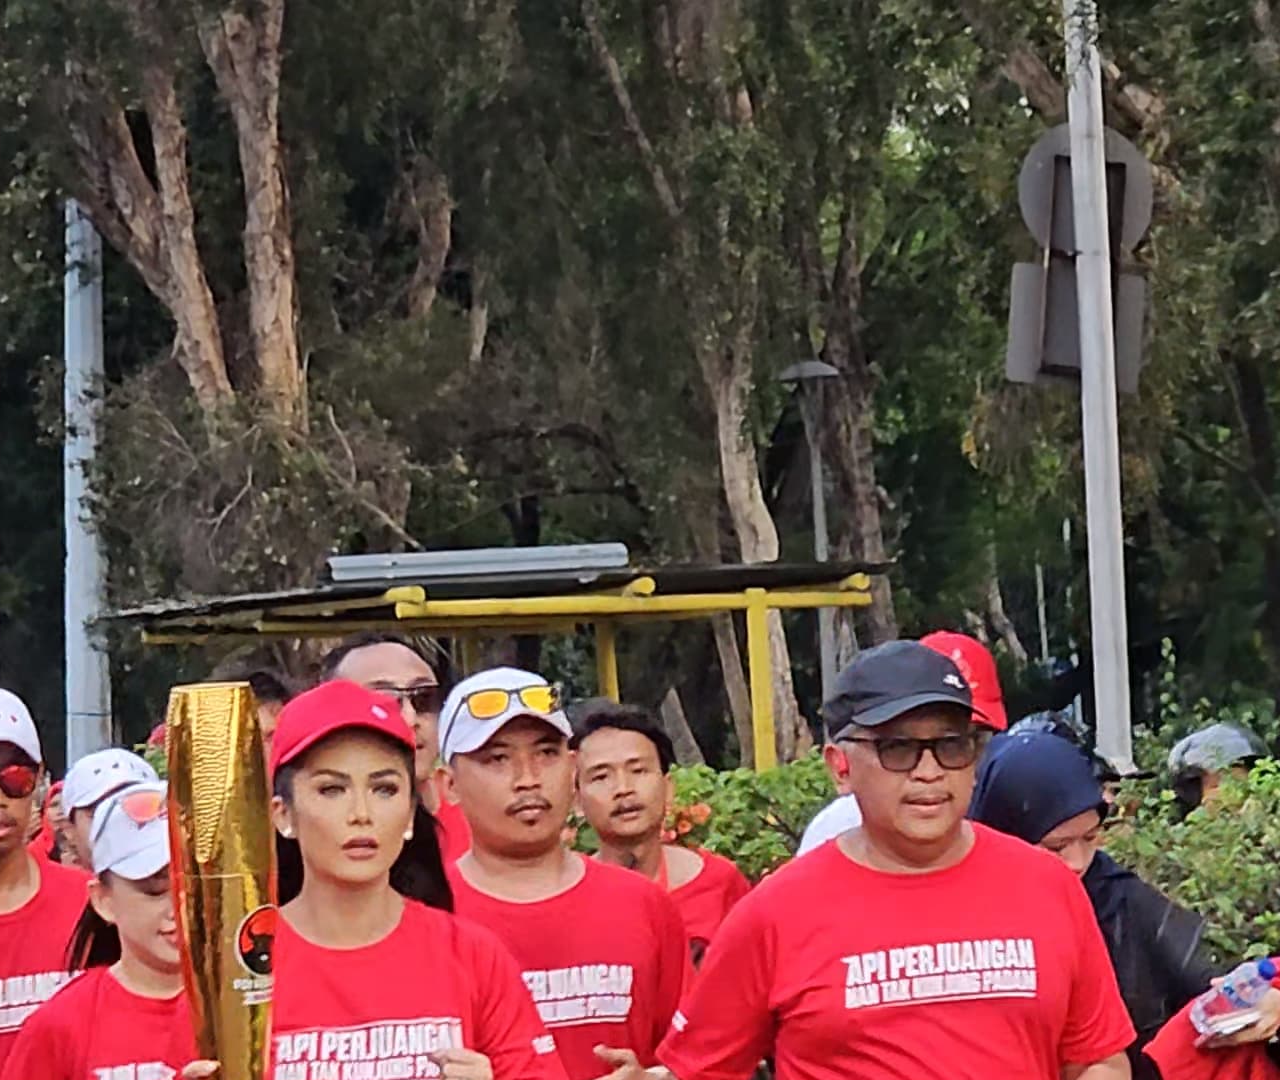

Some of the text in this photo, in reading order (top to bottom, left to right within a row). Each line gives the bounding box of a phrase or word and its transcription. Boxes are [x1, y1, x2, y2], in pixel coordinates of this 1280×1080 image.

[841, 938, 1036, 987] API PERJUANGAN
[275, 1032, 318, 1063] API
